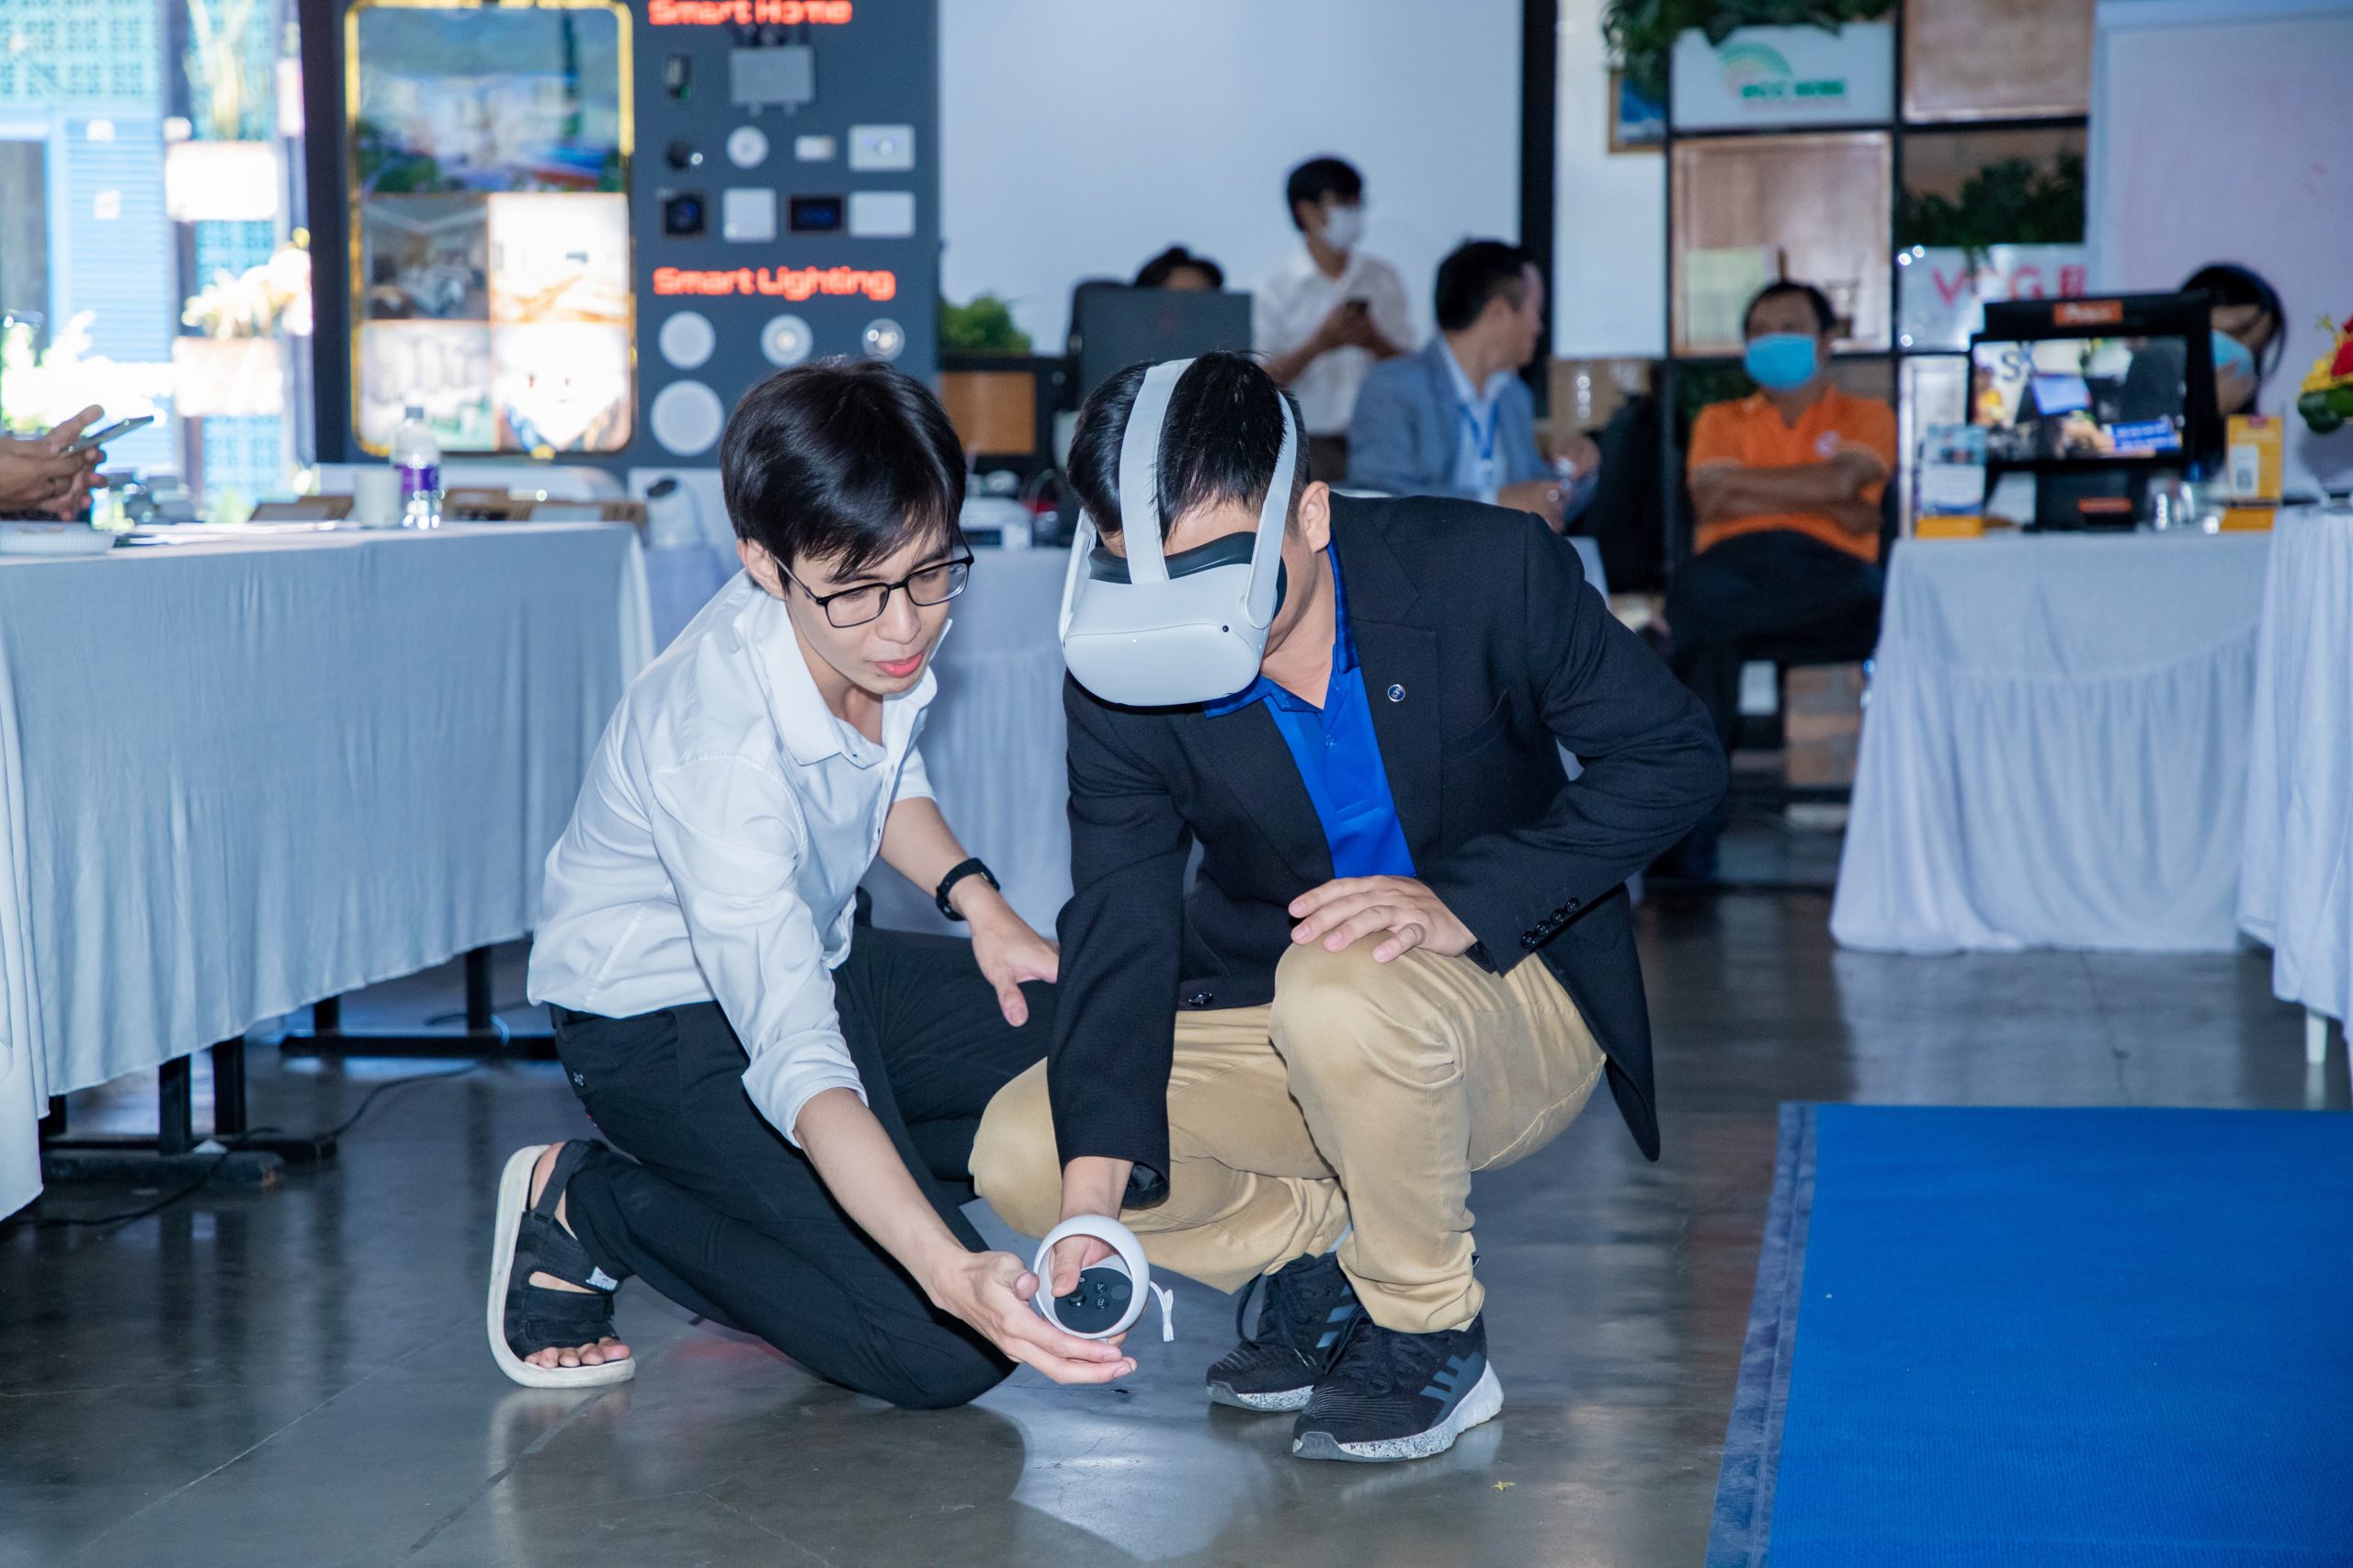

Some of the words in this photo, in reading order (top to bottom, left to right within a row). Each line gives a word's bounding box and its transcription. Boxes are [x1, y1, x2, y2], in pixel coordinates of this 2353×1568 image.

[648, 0, 753, 25] Smart
[754, 0, 853, 25] Home
[653, 267, 756, 295] Smart
[756, 266, 896, 301] Lighting
